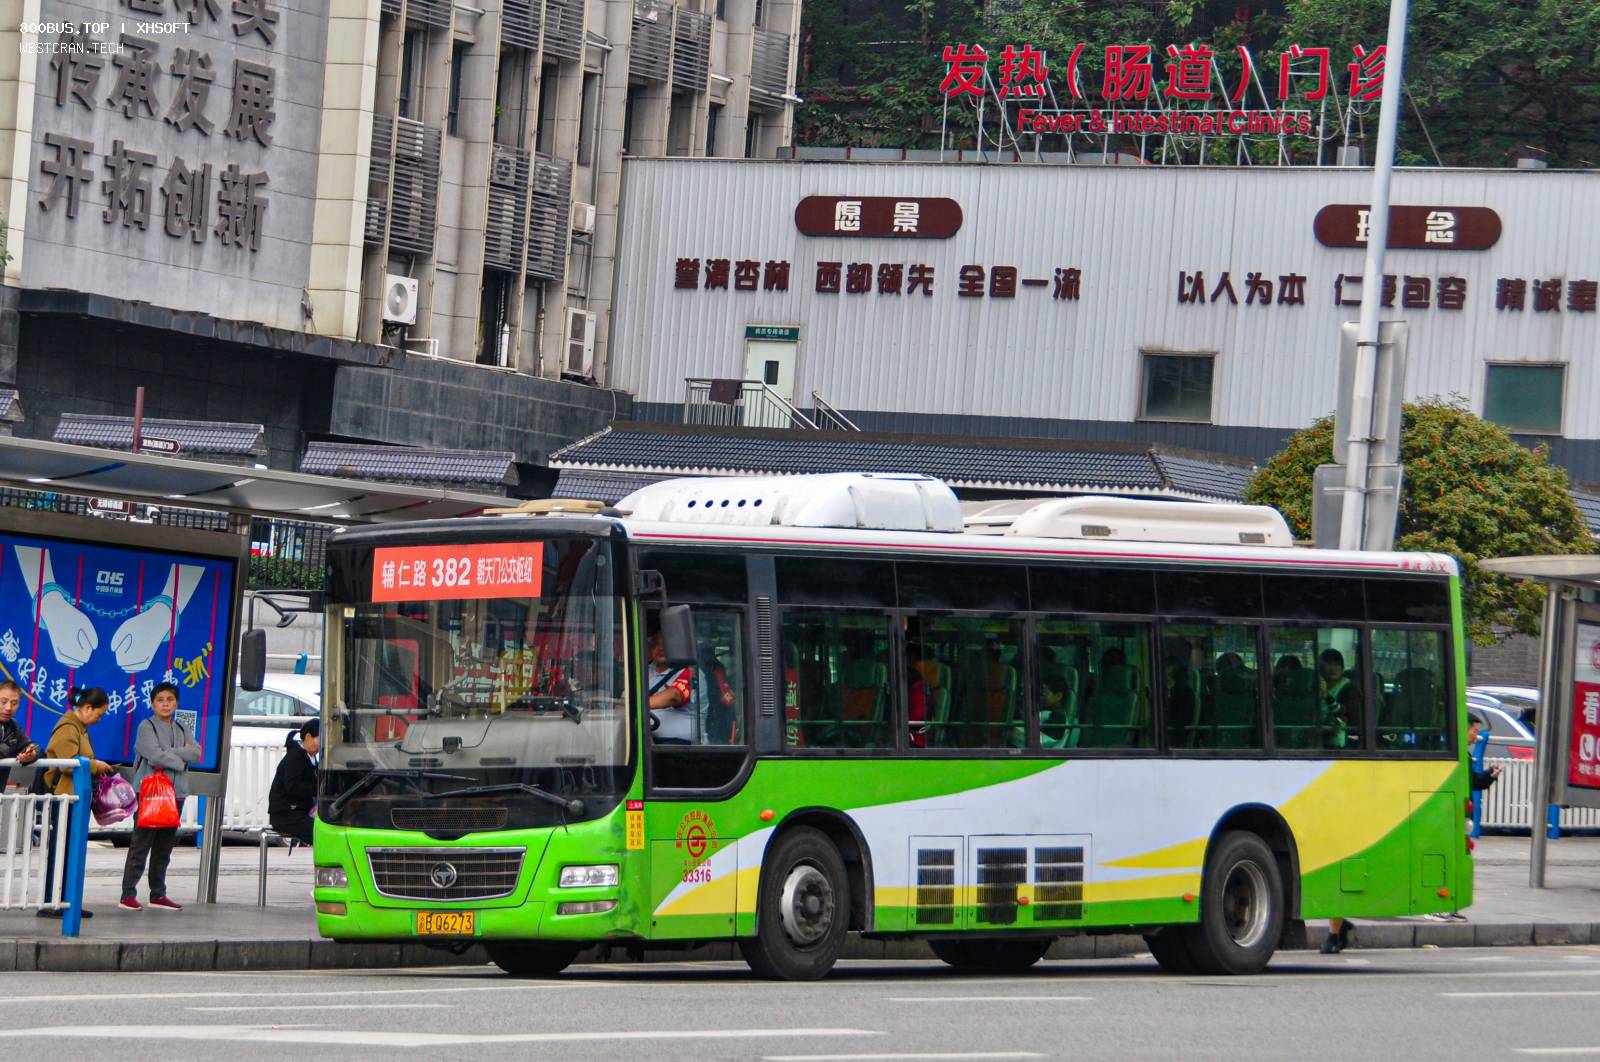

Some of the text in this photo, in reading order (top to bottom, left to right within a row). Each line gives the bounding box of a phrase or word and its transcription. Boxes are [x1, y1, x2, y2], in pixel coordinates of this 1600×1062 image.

[50, 20, 277, 148] 传承发展
[1017, 108, 1311, 134] Fever & Intestinal Clinics
[38, 132, 271, 252] 开拓创新
[674, 257, 1082, 301] 誉满杏林 西部领先 全国一流
[1177, 271, 1307, 305] 以人为本
[382, 556, 534, 588] 辅仁路 382 朝天门公交枢纽
[683, 869, 712, 883] 33316
